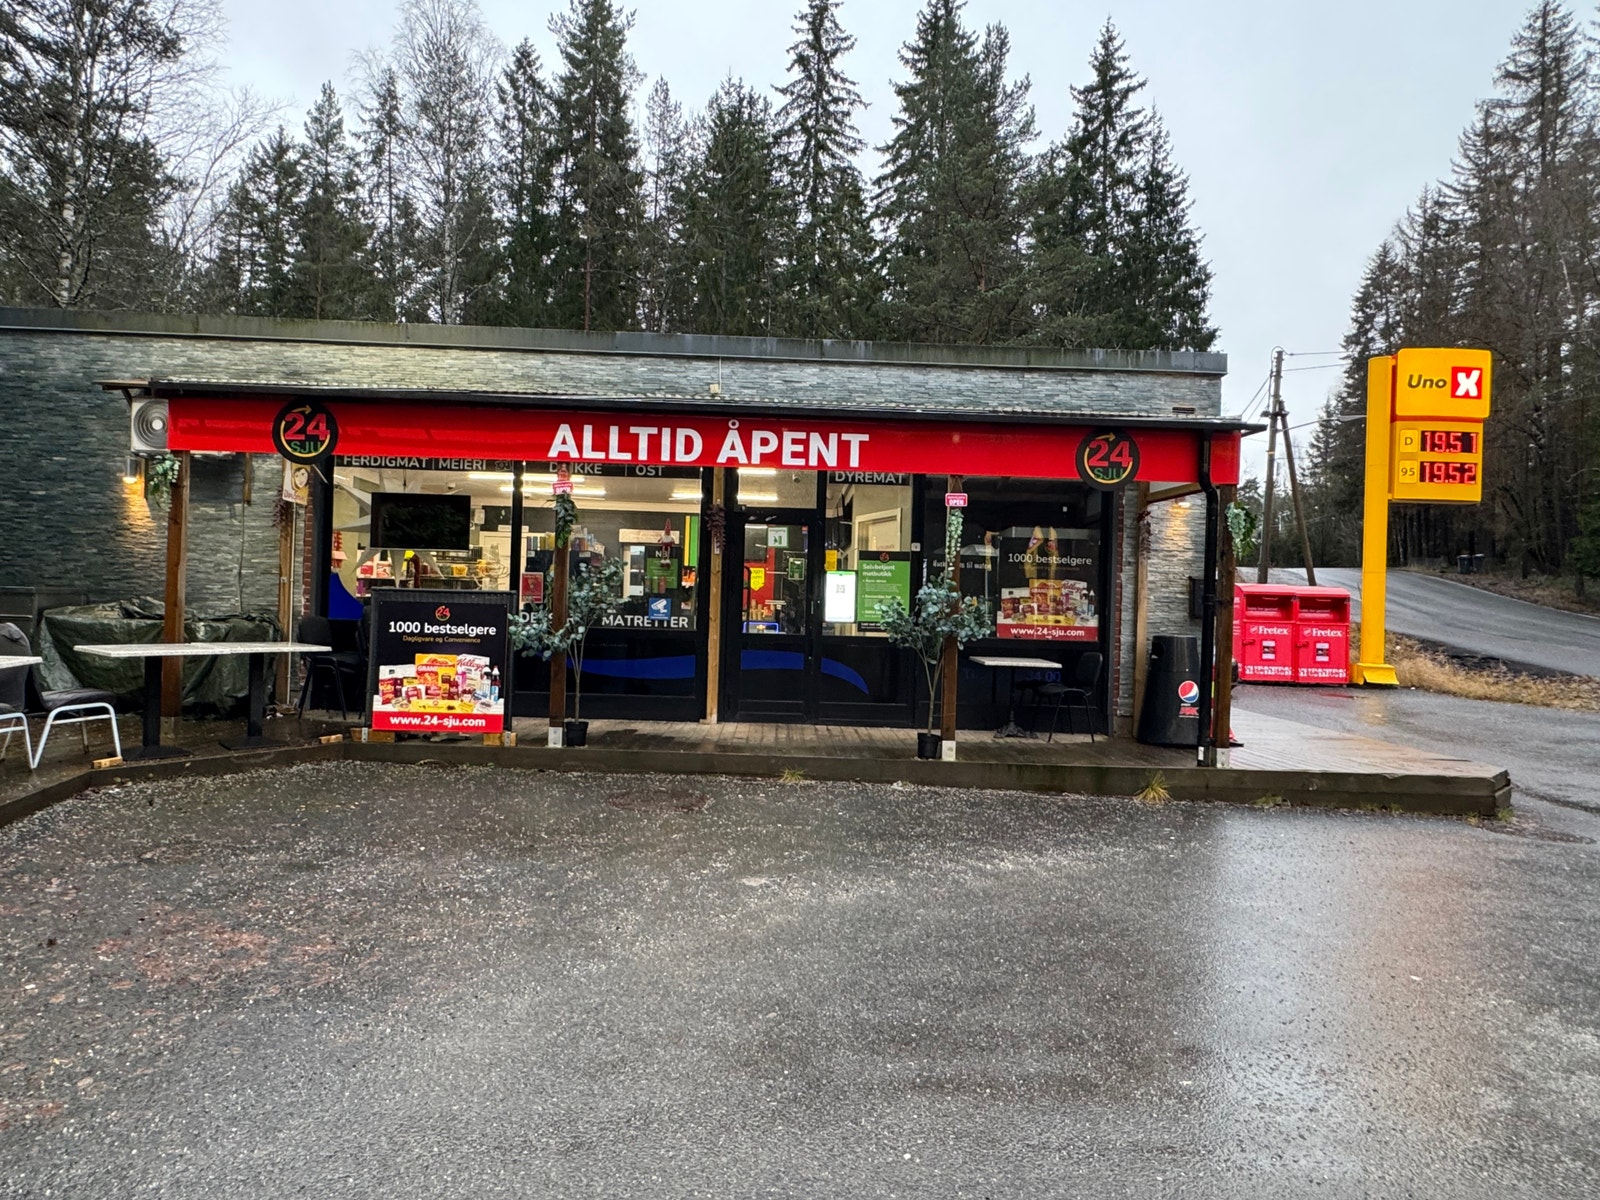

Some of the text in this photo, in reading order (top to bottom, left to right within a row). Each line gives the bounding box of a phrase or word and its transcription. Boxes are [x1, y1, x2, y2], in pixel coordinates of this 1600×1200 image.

[1407, 370, 1480, 396] Uno X
[284, 412, 331, 441] 24
[290, 441, 321, 454] SJU
[547, 419, 870, 467] ALLTID ÅPENT
[1404, 437, 1413, 446] D
[1088, 439, 1133, 467] 24
[343, 456, 429, 468] FERDIGMAT
[438, 458, 487, 470] MEIERI
[549, 462, 603, 475] DIKKE
[635, 465, 665, 476] OST
[1094, 468, 1123, 480] SJU
[1401, 467, 1416, 476] 95
[1423, 462, 1476, 484] 19.52
[835, 471, 905, 484] DYREMAT
[1008, 553, 1092, 566] 1000 bestselgere
[388, 621, 497, 636] 1000 bestselgere
[1010, 627, 1085, 638] www.24-sju.com
[1258, 626, 1289, 635] Fretex
[1312, 628, 1342, 637] Fretex
[402, 635, 434, 643] Dagligvare
[389, 715, 486, 728] www.24-sju.com
